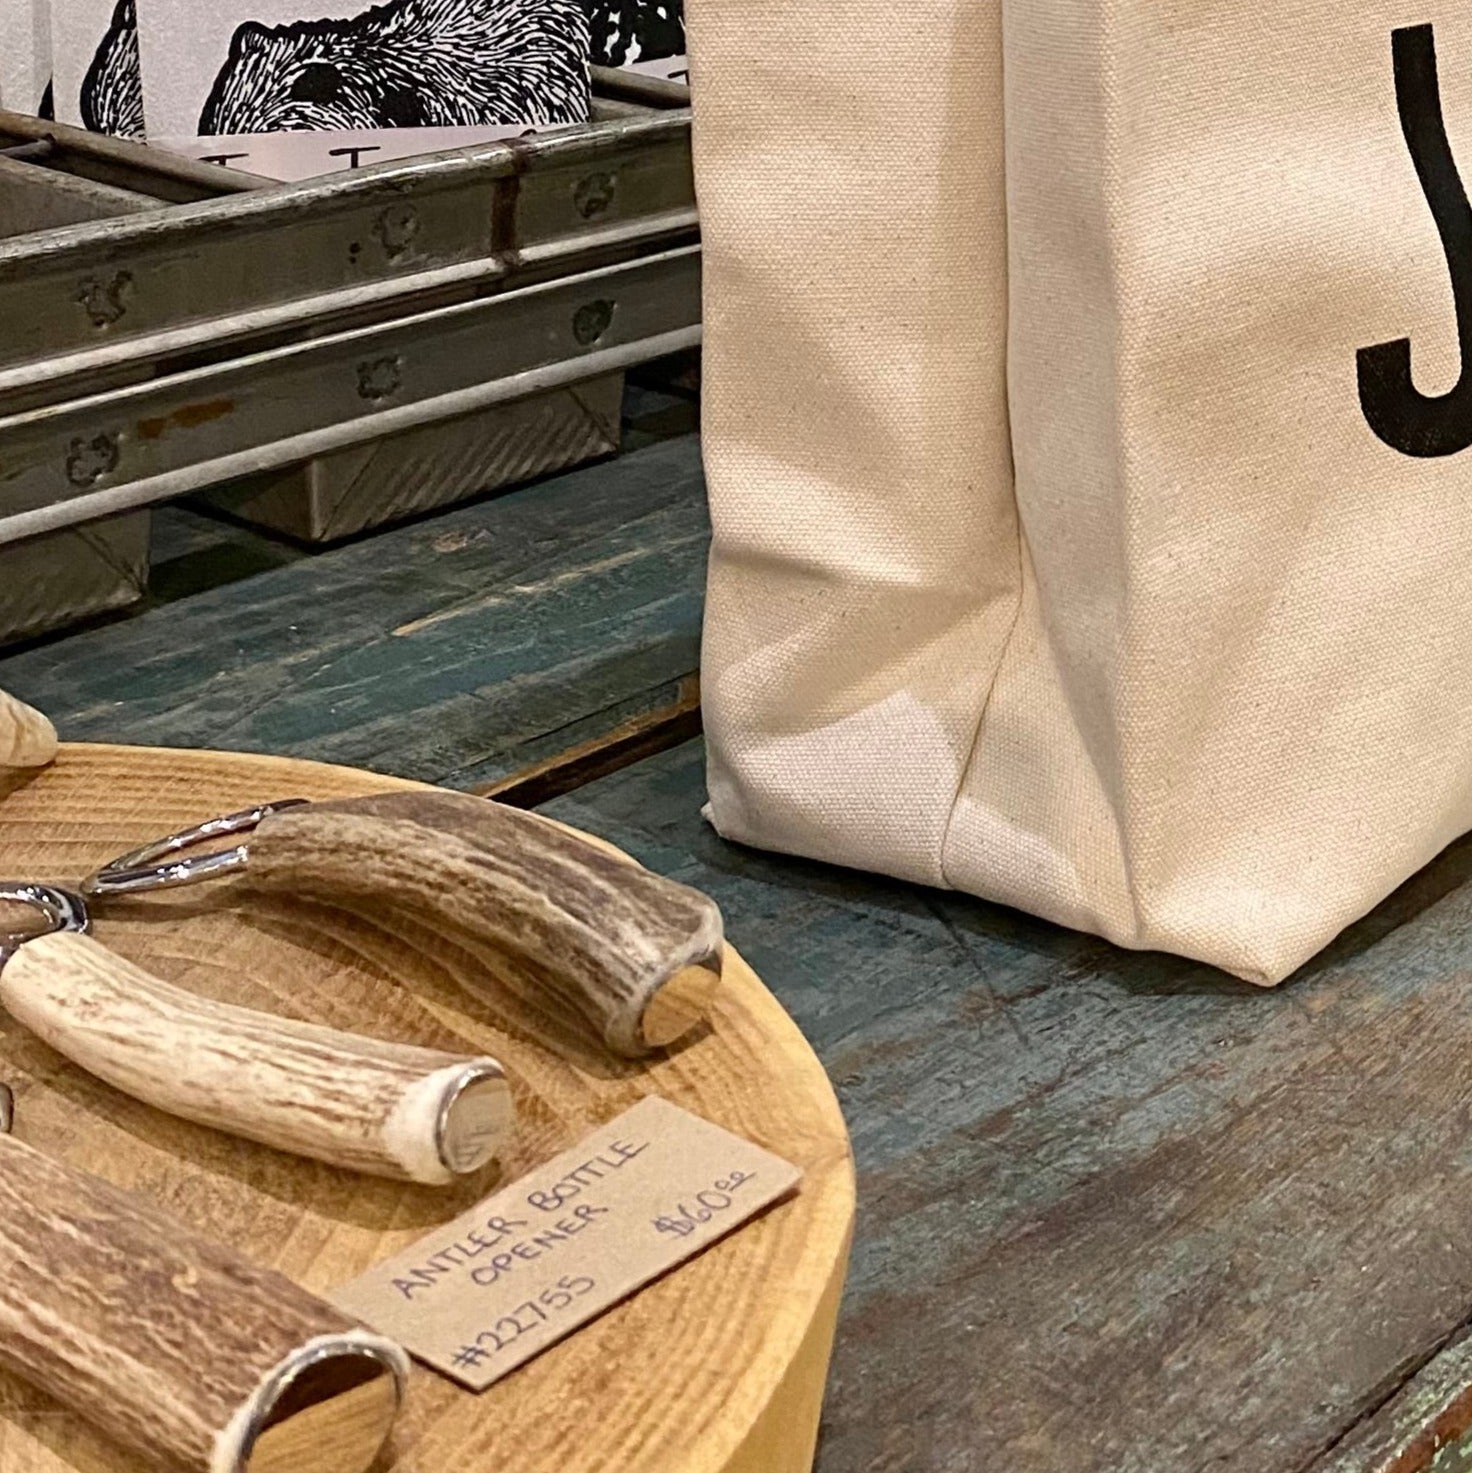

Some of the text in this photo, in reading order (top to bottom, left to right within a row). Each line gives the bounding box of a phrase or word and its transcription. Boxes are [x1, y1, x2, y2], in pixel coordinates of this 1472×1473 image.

[391, 1139, 650, 1300] ANTLER BOTTLE
[471, 1203, 609, 1287] OPENER
[451, 1274, 597, 1371] #22755
